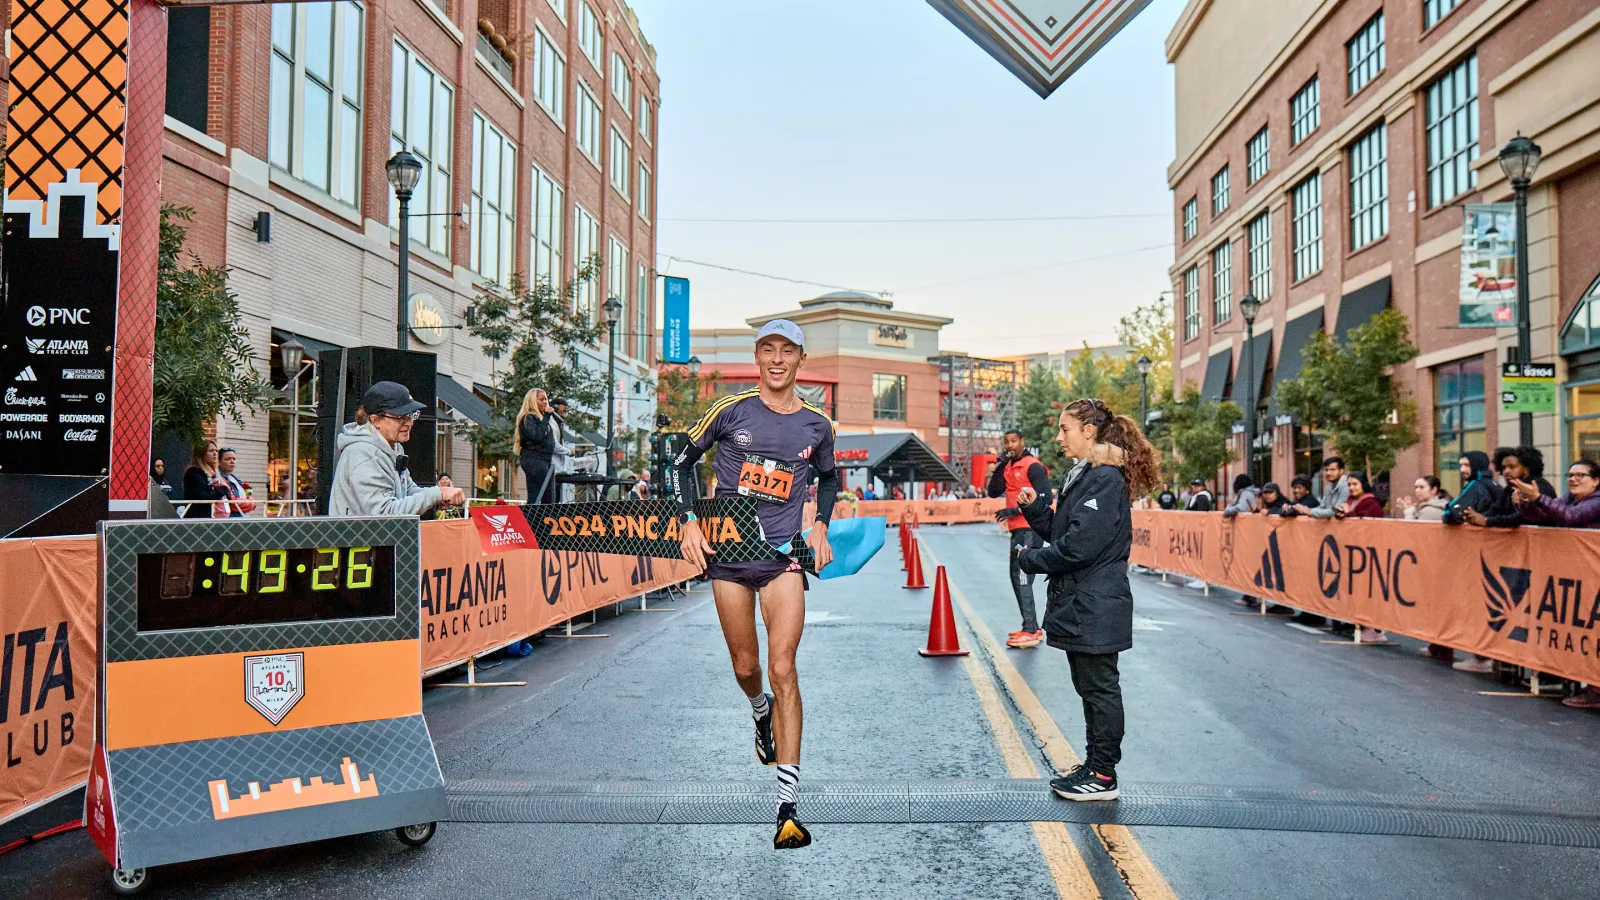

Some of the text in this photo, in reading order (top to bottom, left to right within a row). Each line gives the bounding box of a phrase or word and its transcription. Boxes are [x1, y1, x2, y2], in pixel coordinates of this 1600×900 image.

[48, 308, 91, 324] PNC
[46, 340, 89, 350] ATLANTA
[0, 413, 48, 422] POWERADE
[59, 414, 105, 423] BODYARMOR
[6, 429, 42, 441] DASANI
[740, 470, 788, 493] A3171
[543, 514, 607, 537] 2024
[611, 514, 659, 541] PNC
[490, 532, 525, 543] ATLANTA
[1344, 544, 1418, 608] PNC
[420, 558, 507, 617] ATLANTA
[427, 603, 507, 643] RACK CLUB
[265, 671, 285, 687] 10
